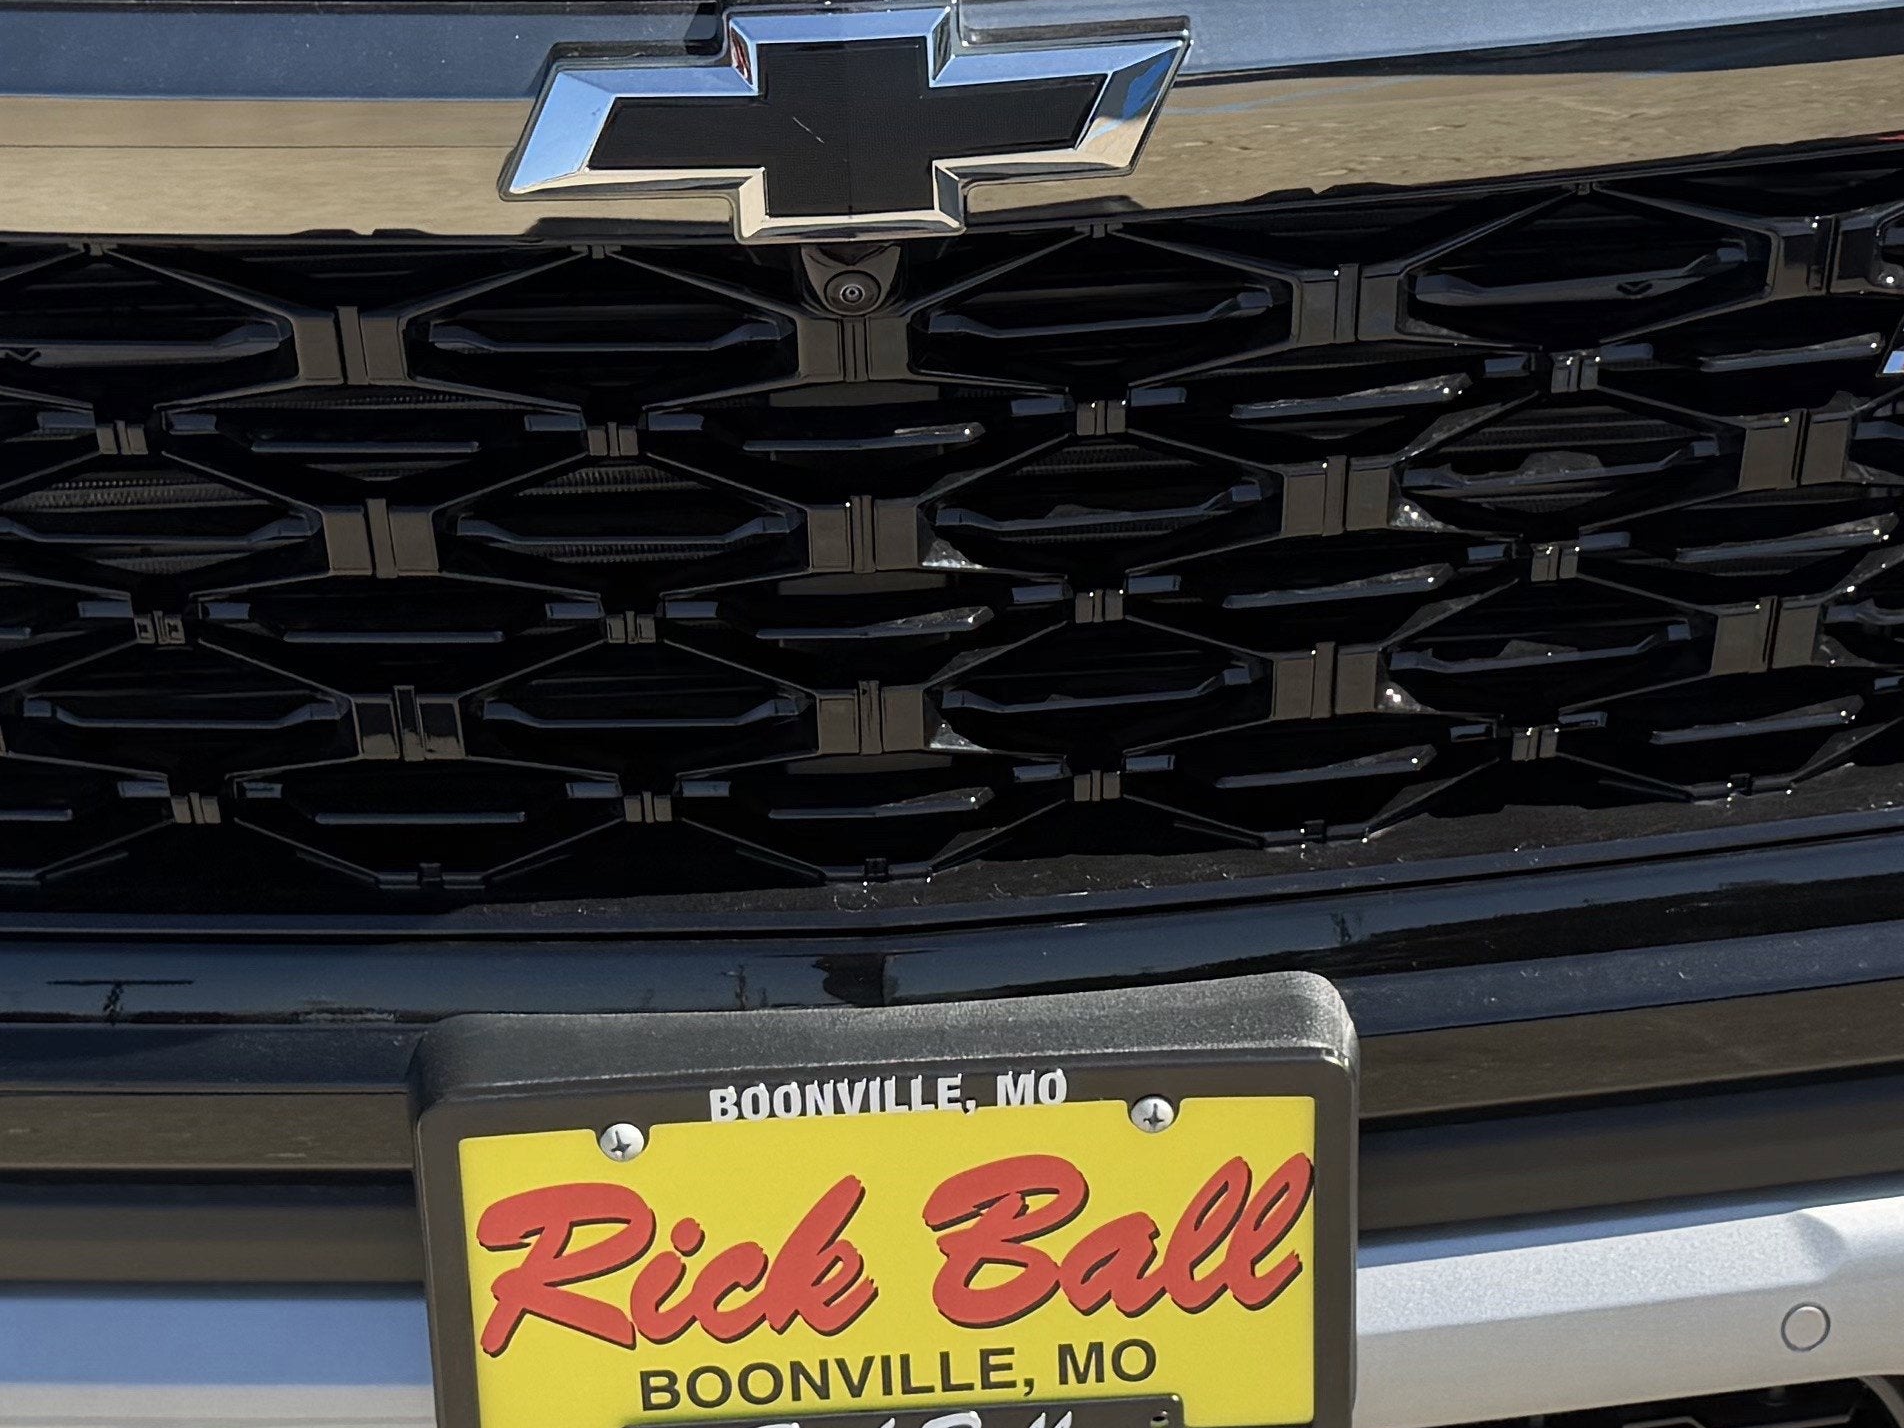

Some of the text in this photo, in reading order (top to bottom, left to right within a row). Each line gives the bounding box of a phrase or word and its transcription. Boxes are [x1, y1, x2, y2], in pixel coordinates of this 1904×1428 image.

[708, 1068, 1068, 1122] BOONVILLE, MO
[476, 1152, 1313, 1357] Rick Ball
[640, 1338, 1156, 1411] BOONVILLE, MO
